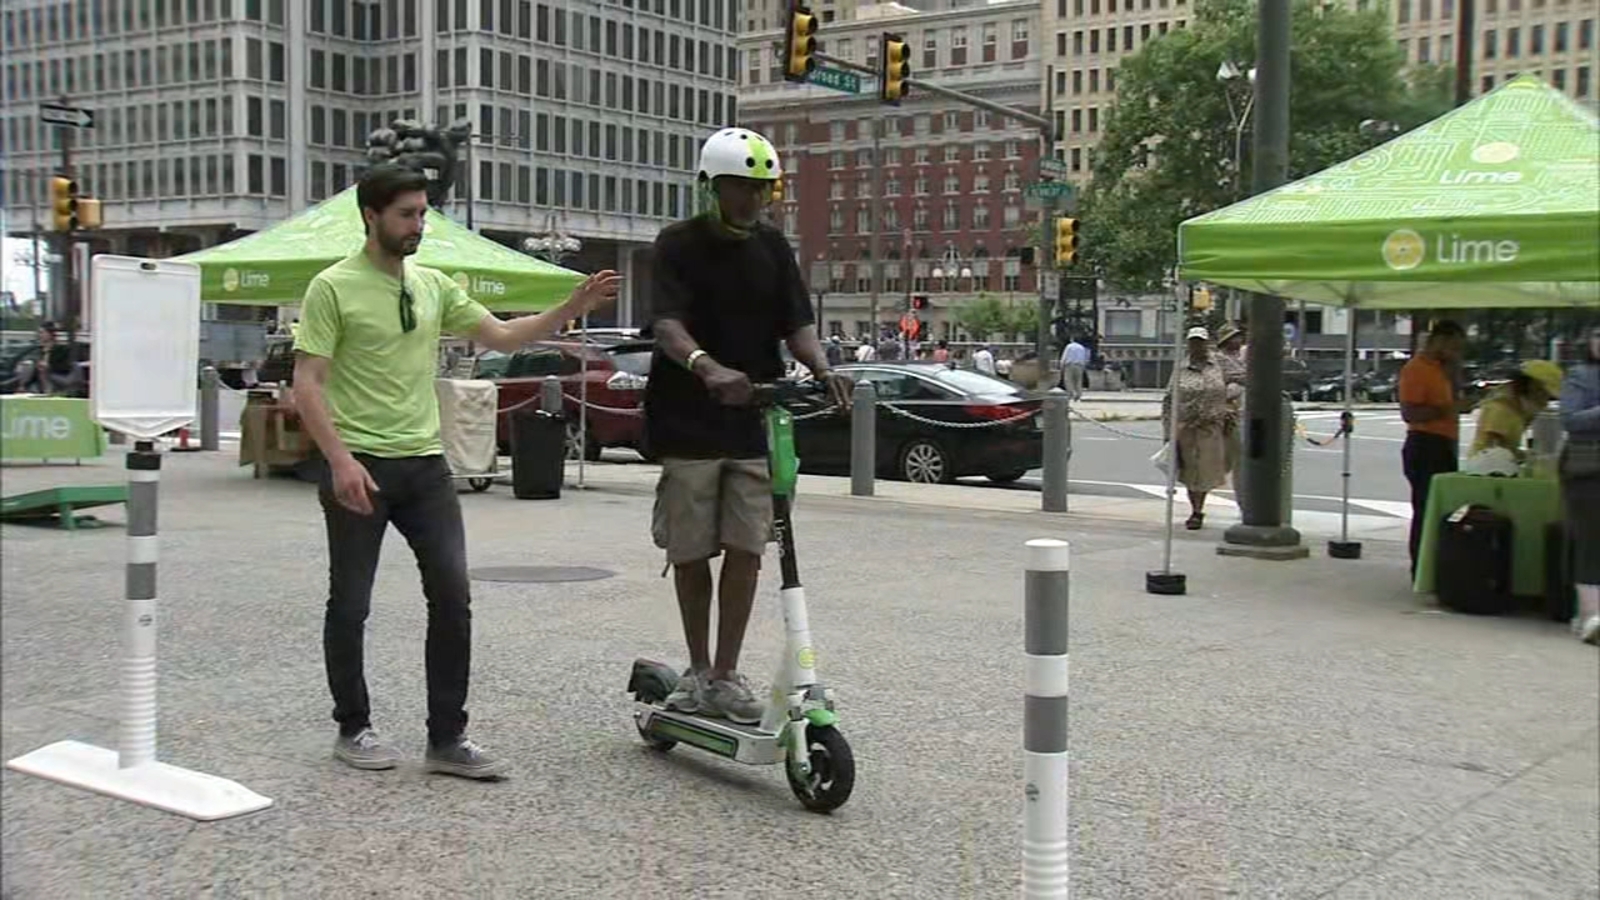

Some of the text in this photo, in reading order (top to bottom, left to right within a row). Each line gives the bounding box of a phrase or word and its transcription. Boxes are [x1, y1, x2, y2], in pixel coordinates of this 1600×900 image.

[1440, 169, 1522, 185] Lime
[1437, 234, 1520, 262] Lime
[240, 270, 270, 287] Lime
[472, 275, 506, 295] Lime
